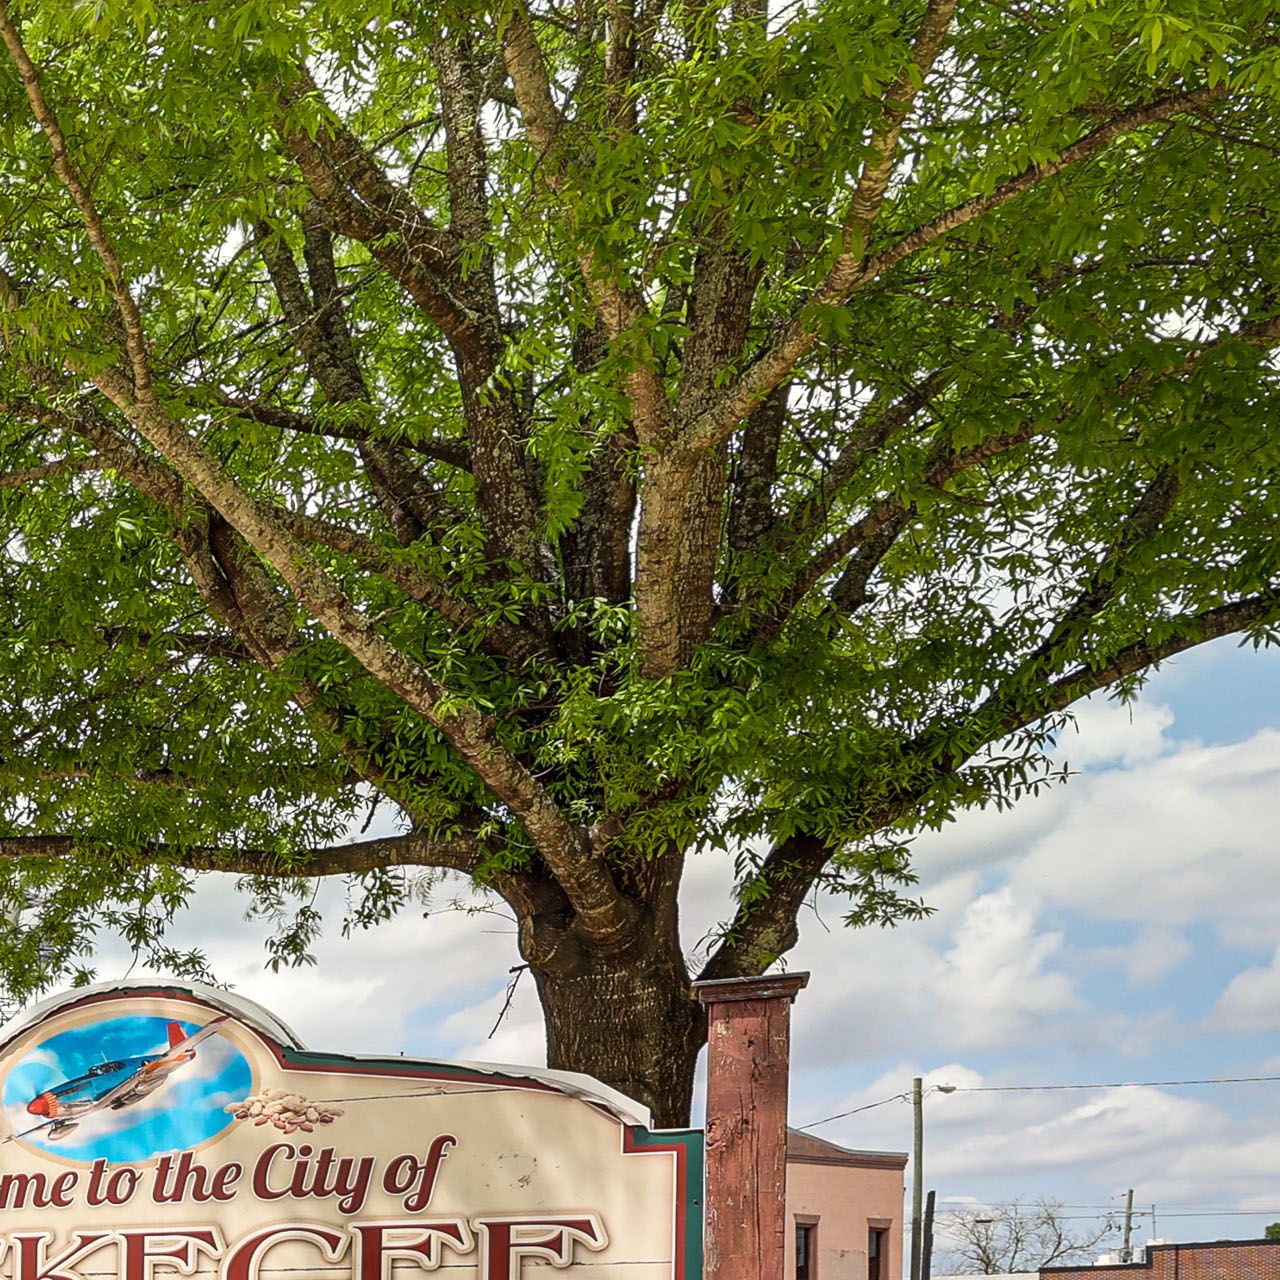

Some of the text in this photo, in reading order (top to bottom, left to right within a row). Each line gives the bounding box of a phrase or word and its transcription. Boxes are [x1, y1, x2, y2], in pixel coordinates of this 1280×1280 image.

[87, 1158, 143, 1206] to
[152, 1150, 243, 1204] the
[252, 1141, 376, 1215] City
[382, 1134, 458, 1214] of
